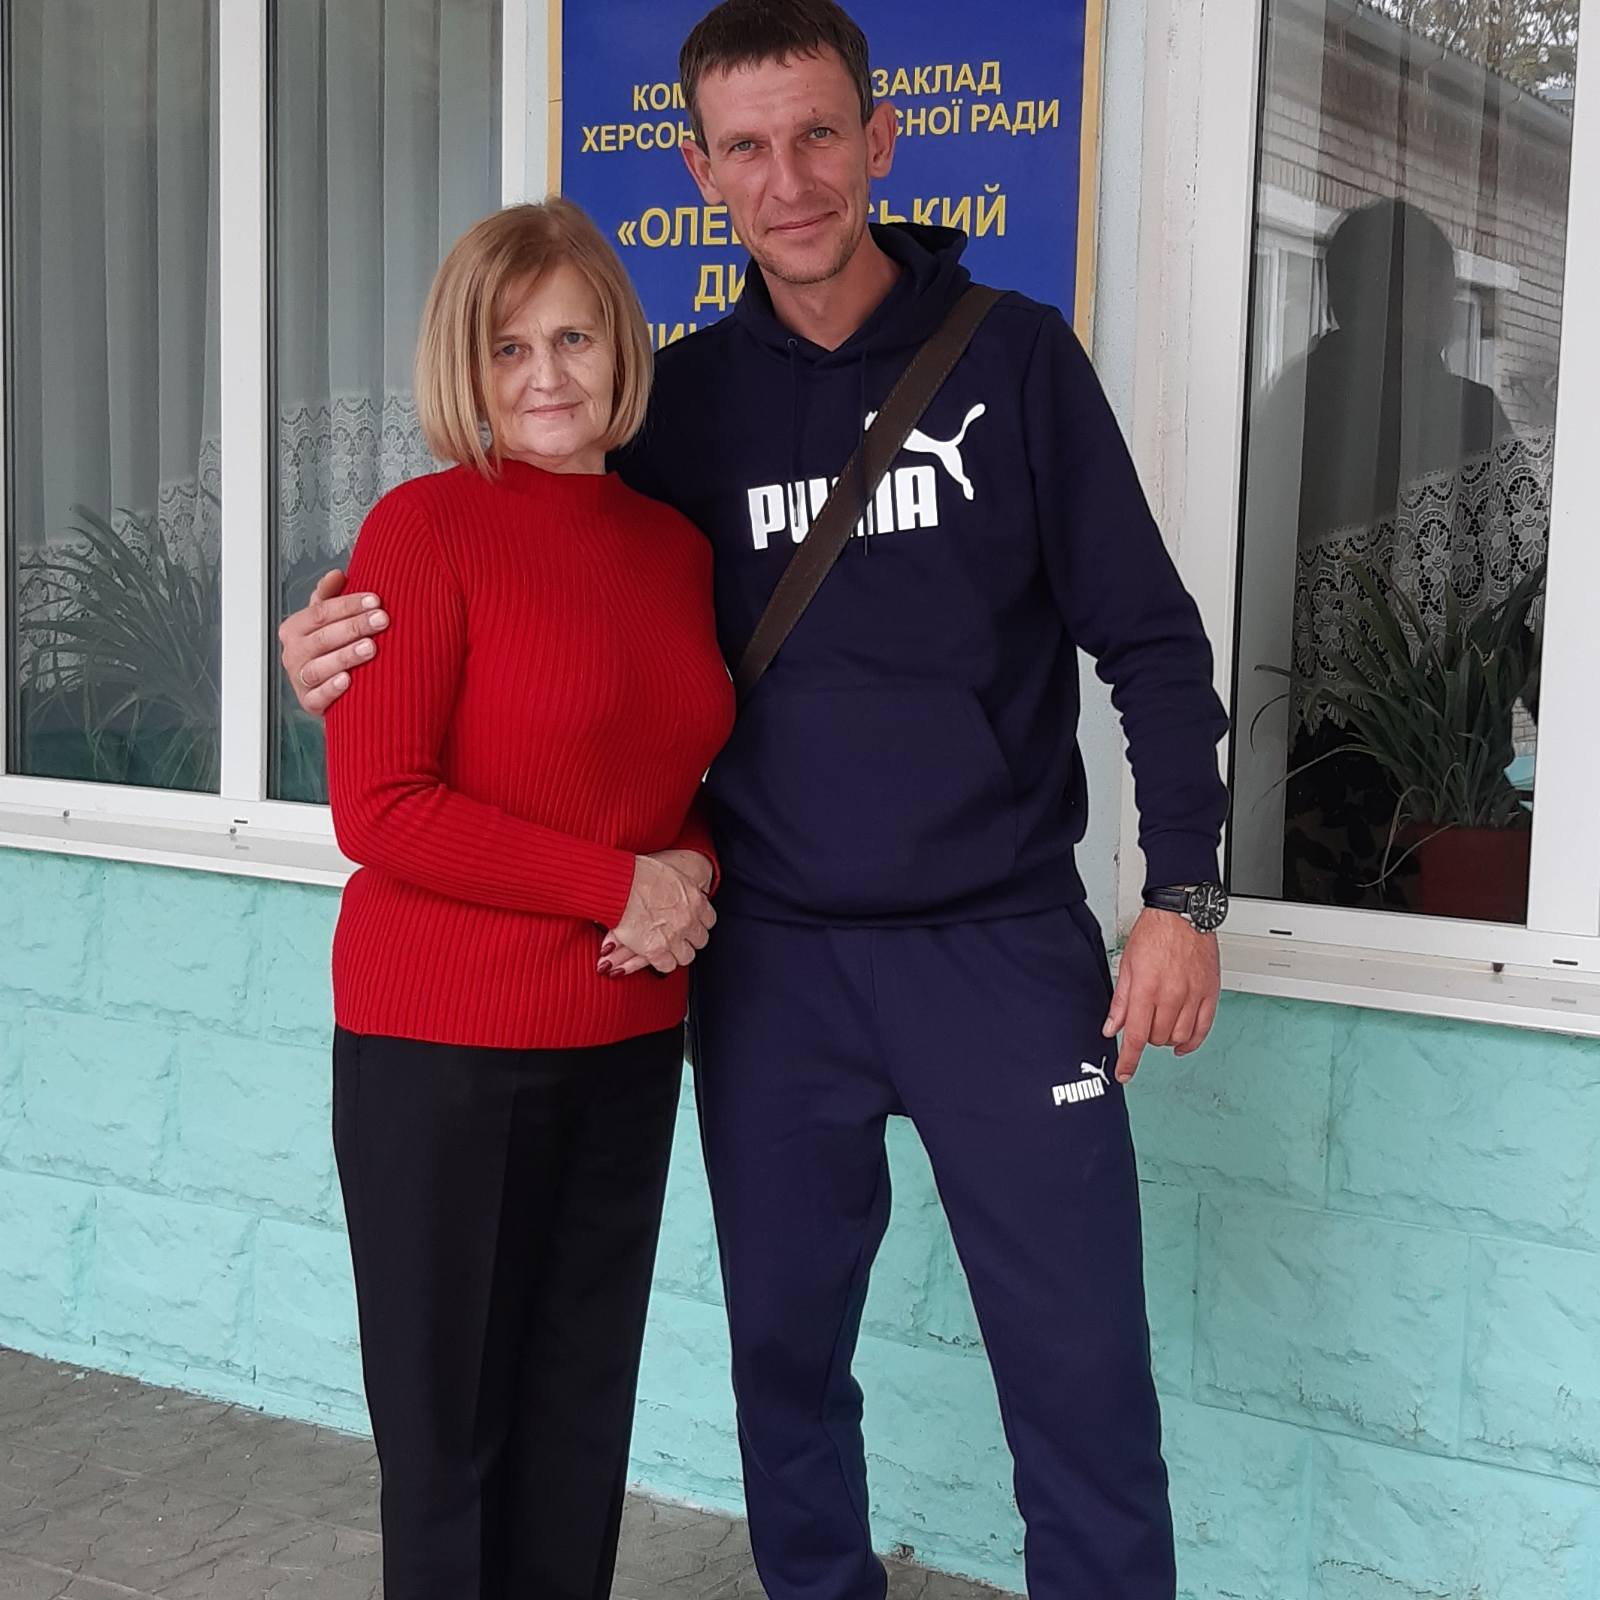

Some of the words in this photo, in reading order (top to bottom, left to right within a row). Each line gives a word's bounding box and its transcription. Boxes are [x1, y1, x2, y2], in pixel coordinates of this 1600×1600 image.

[632, 82, 686, 112] КОМ
[871, 61, 1001, 98] ЗАКЛАД
[581, 121, 696, 153] ХЕРСОН
[895, 99, 964, 137] НОЇ
[970, 99, 1060, 136] РАДИ
[617, 205, 742, 248] «ОЛЕ
[868, 183, 1006, 237] ЬКИЙ
[1052, 1076, 1105, 1106] PUMA
